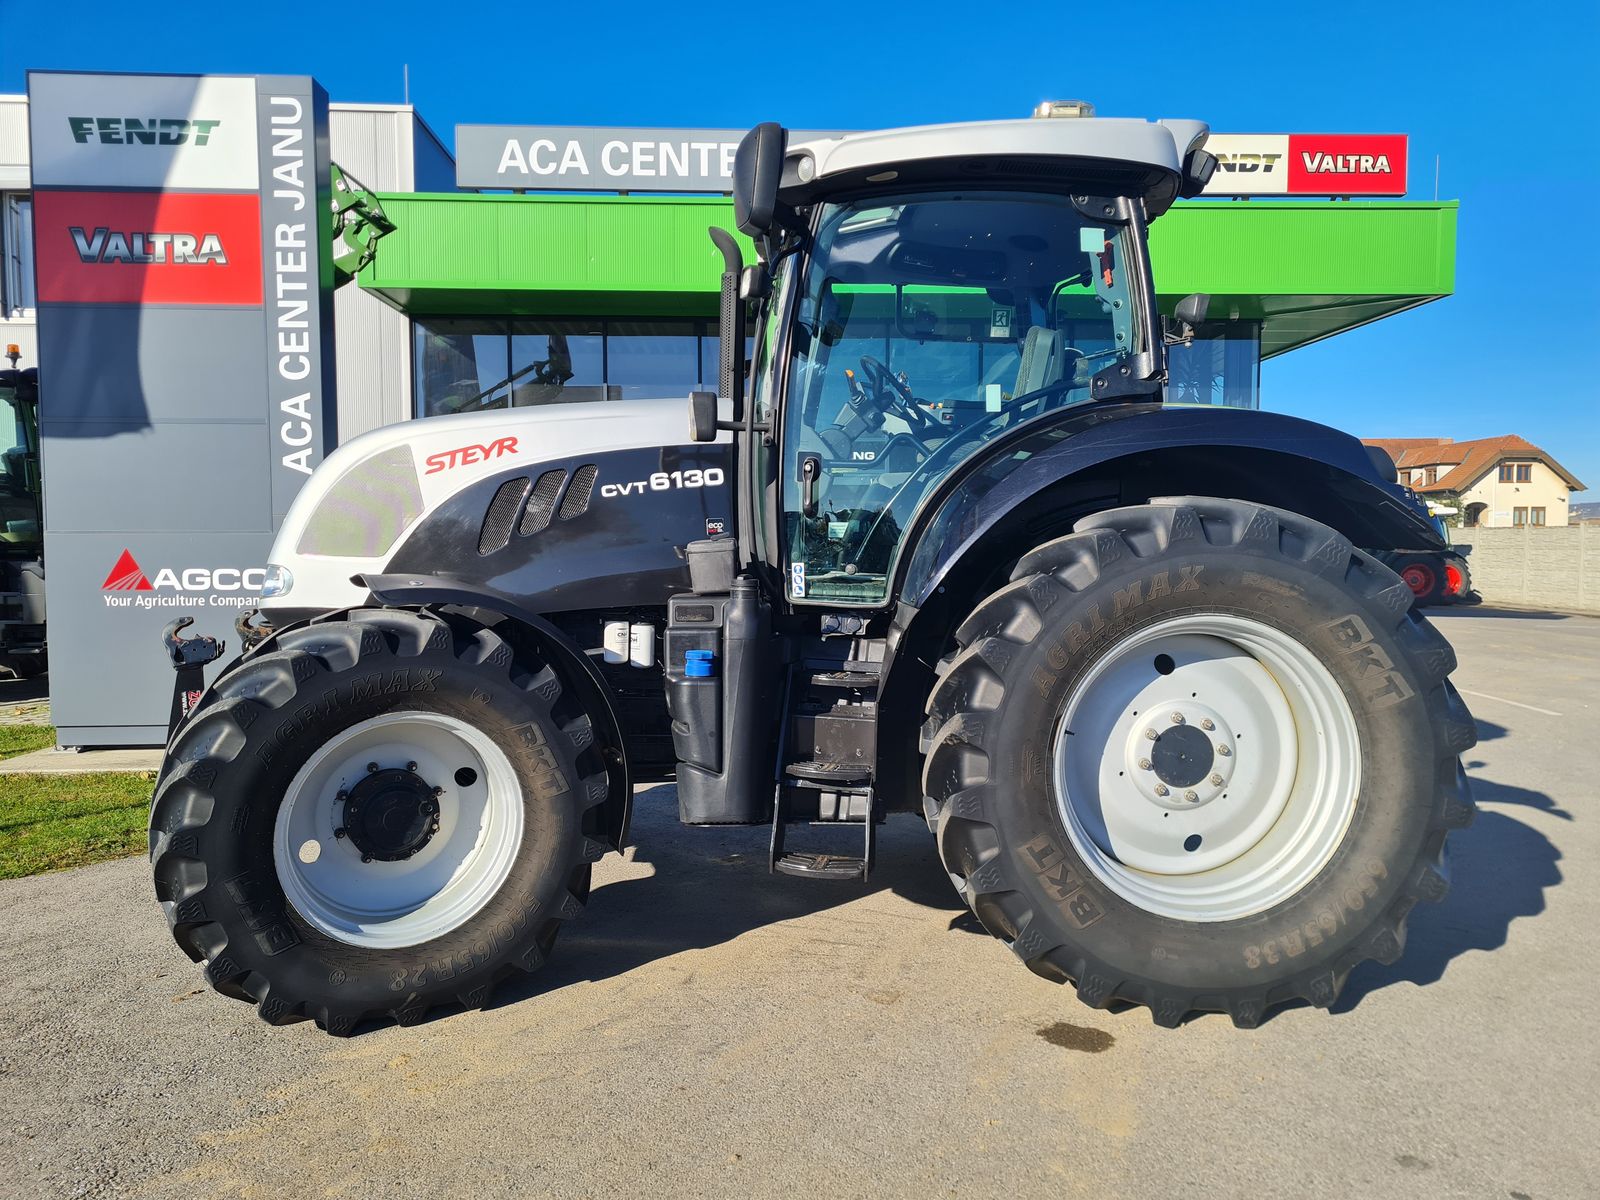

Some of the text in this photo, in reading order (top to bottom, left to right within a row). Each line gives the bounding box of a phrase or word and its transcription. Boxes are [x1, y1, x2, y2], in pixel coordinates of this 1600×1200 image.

[68, 116, 221, 146] FENDT
[497, 139, 740, 177] ACA CENTE
[1215, 153, 1283, 173] NDT
[1300, 151, 1392, 174] VALTRA
[68, 227, 229, 265] VALTRA
[270, 96, 313, 475] ACA CENTER JANU
[425, 436, 519, 475] STEYR
[852, 451, 875, 461] NG
[600, 468, 725, 499] CVT 6130
[103, 594, 261, 609] Your Agriculture Compan
[1326, 618, 1408, 704] BKT
[1025, 843, 1103, 927] BKT
